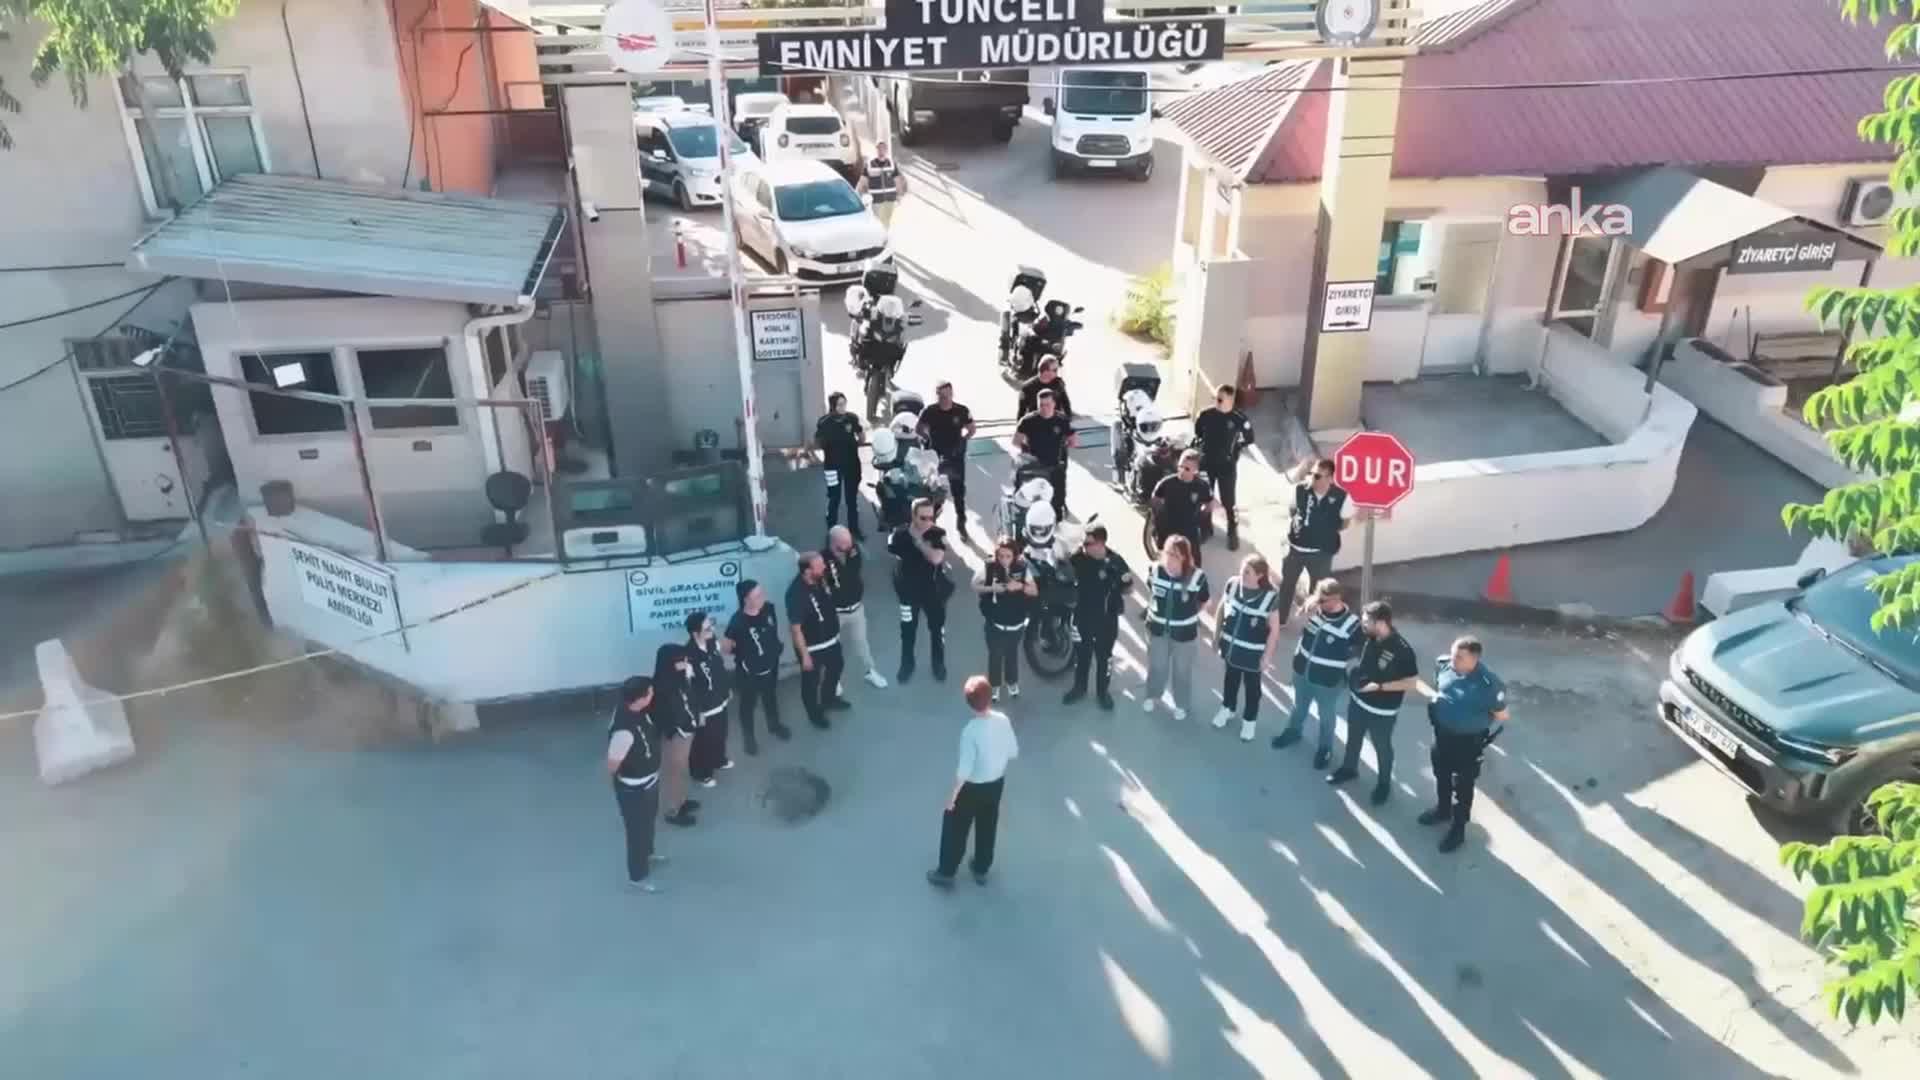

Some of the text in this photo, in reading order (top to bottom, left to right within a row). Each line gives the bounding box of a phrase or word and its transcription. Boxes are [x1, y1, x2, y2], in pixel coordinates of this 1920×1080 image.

[780, 23, 1208, 70] EMNİYET MÜDÜRLÜĞÜ
[1737, 241, 1836, 264] ZİYARETÇİ GİRİŞİ
[1341, 455, 1406, 487] DUR
[353, 573, 388, 599] BULUT
